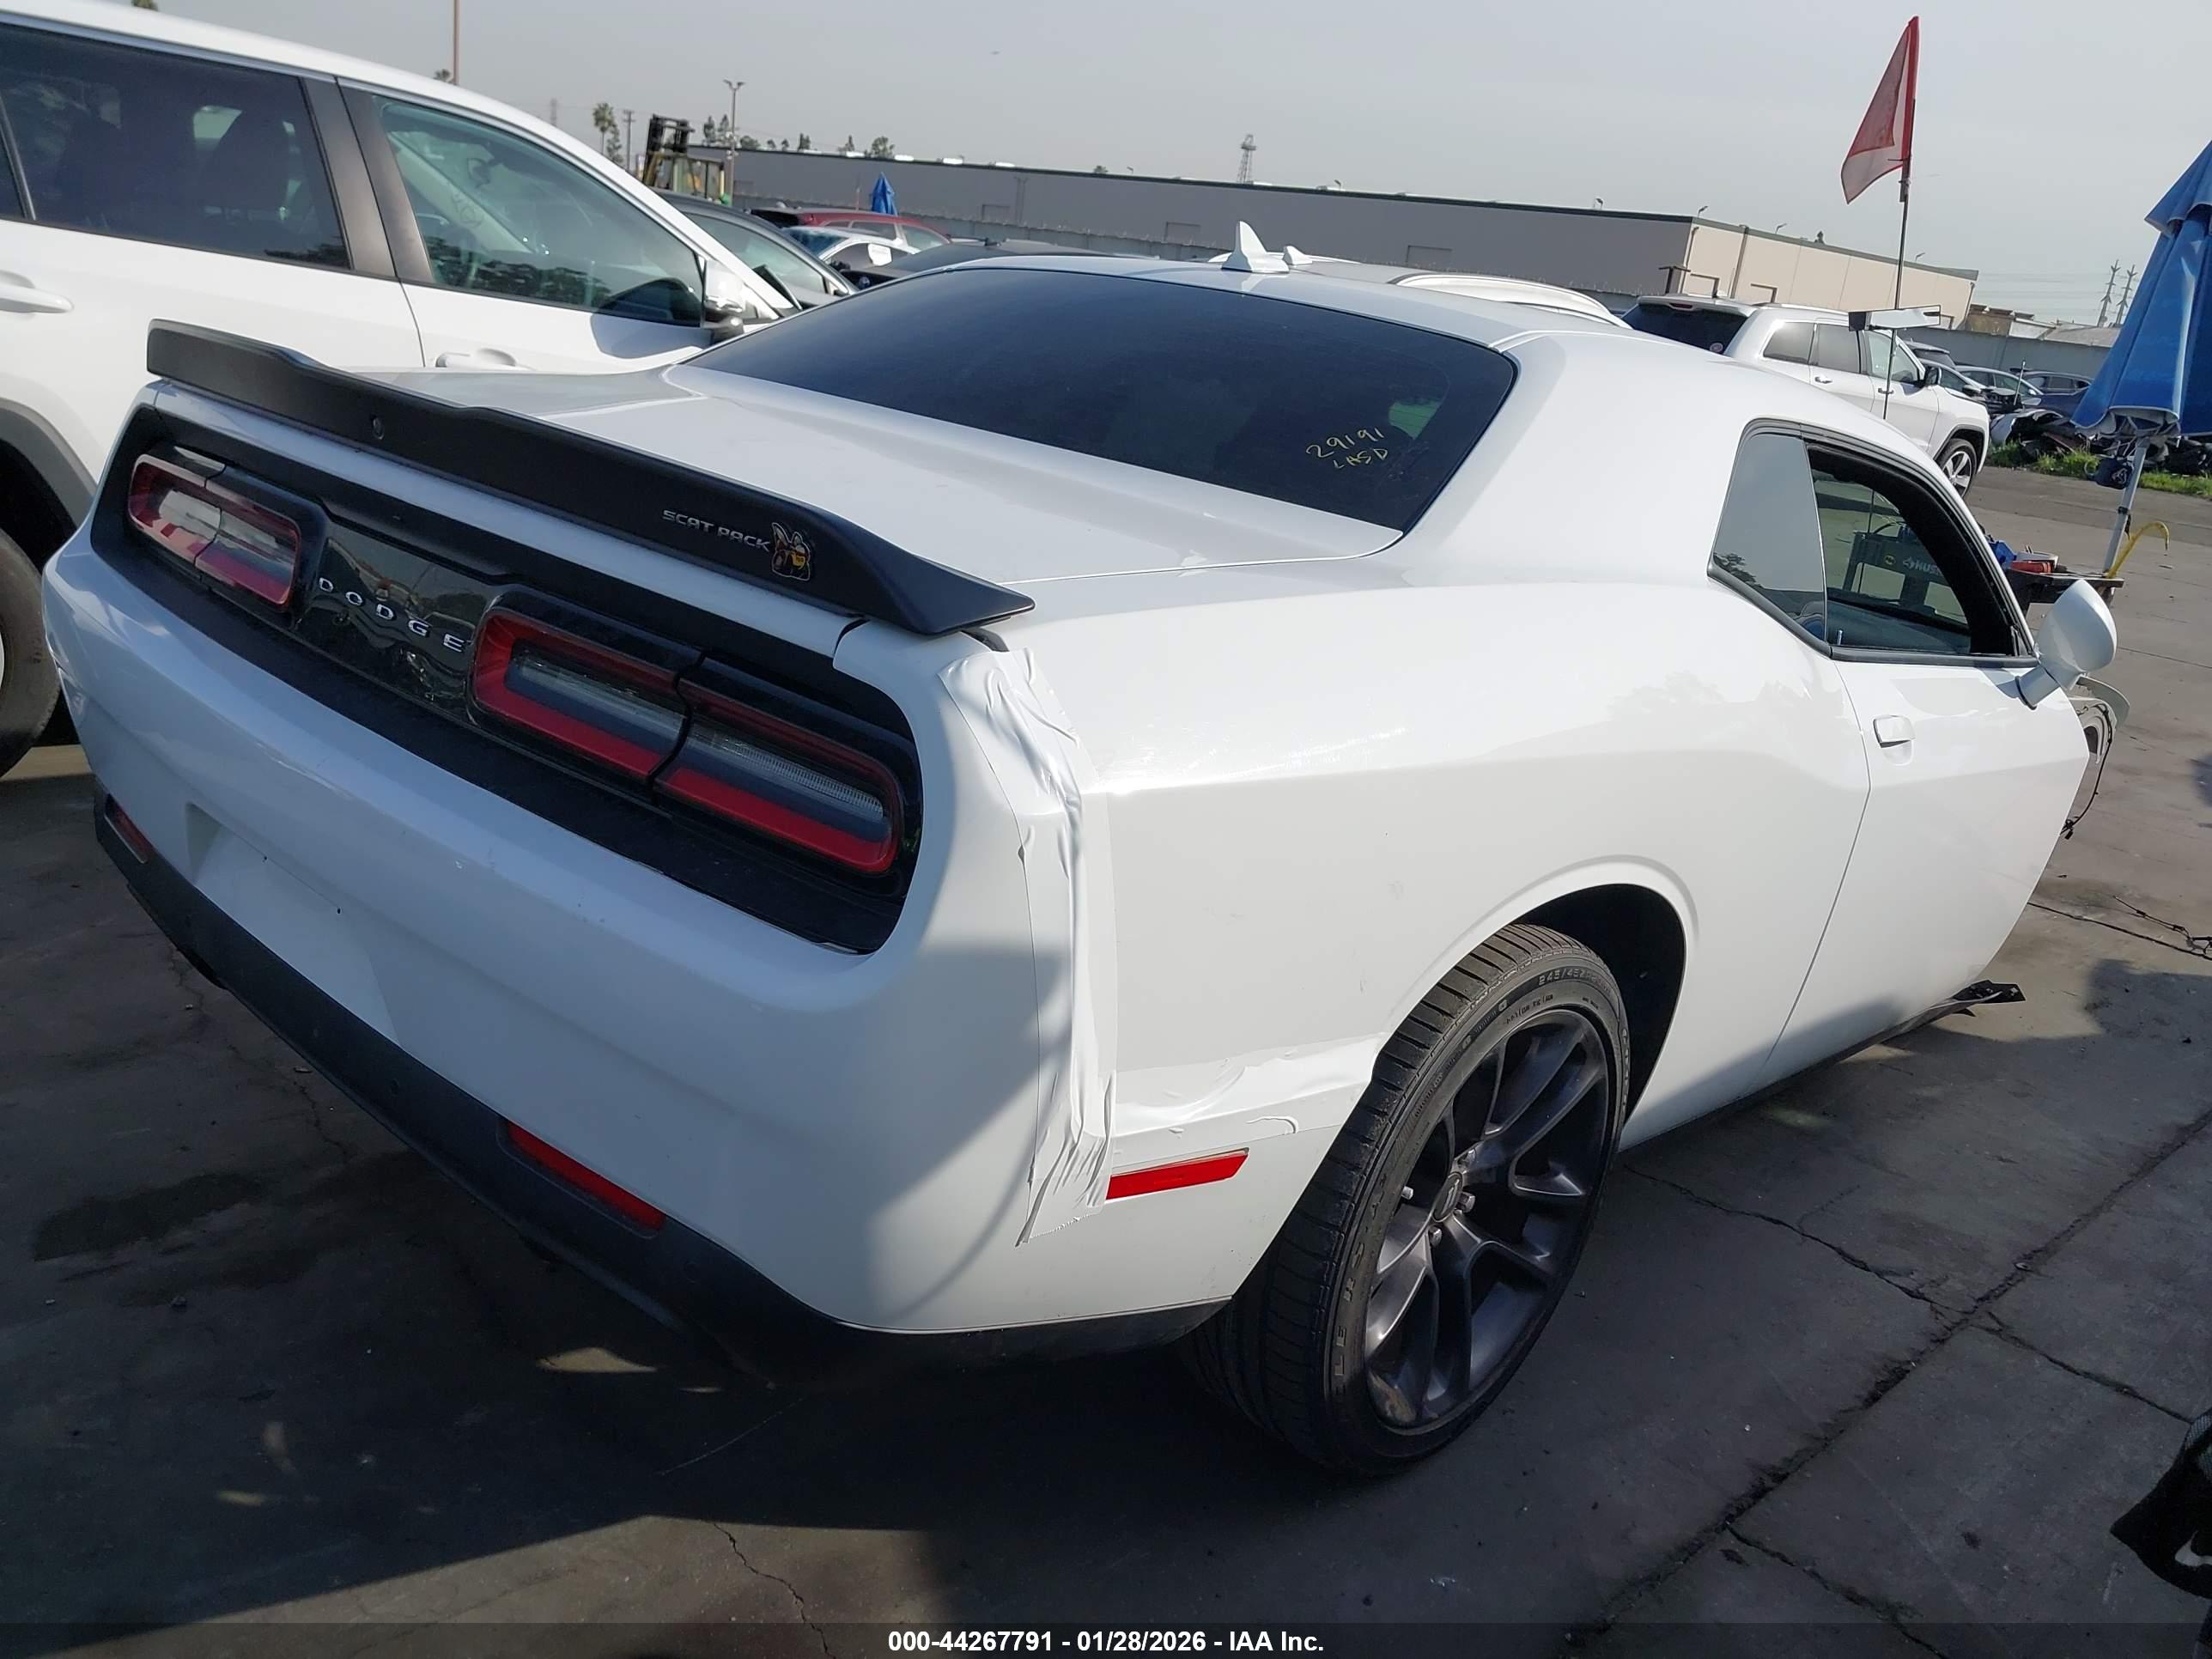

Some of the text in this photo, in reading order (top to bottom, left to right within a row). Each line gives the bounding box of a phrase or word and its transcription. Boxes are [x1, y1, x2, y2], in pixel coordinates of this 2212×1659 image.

[1305, 428, 1384, 458] 29191
[1334, 447, 1388, 469] LASD
[662, 509, 770, 553] SCAT PACK
[319, 577, 465, 653] DODGE
